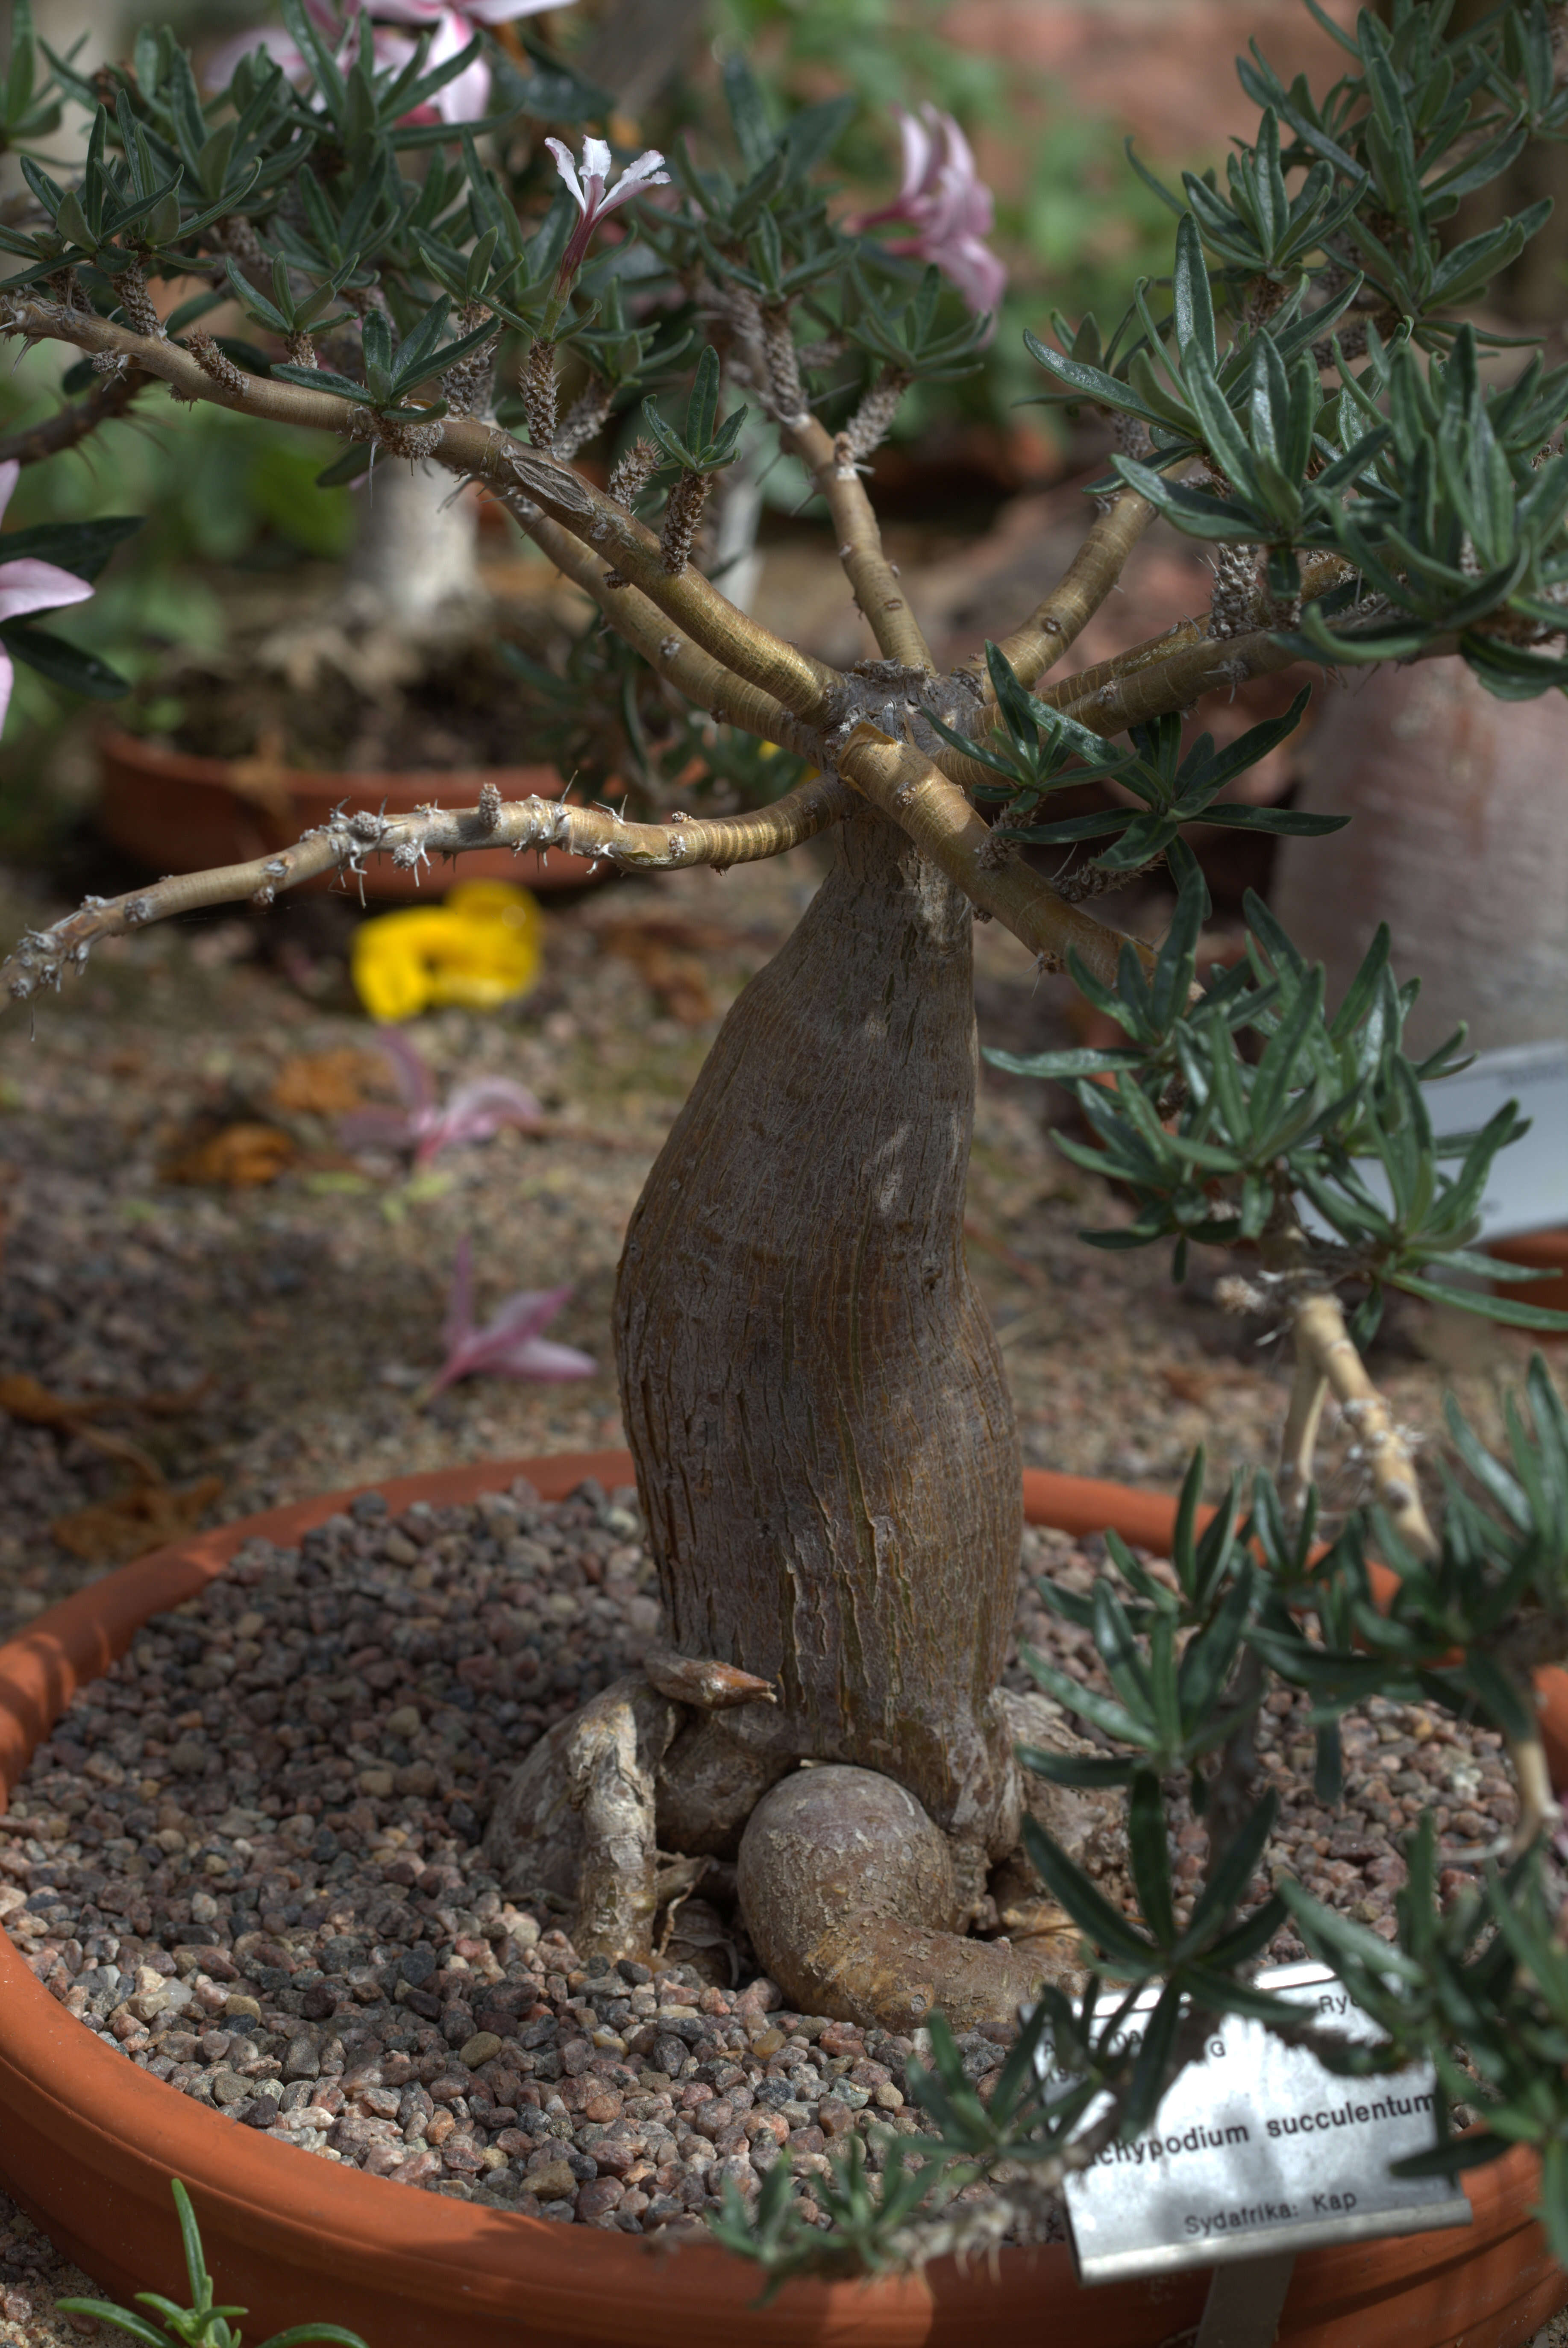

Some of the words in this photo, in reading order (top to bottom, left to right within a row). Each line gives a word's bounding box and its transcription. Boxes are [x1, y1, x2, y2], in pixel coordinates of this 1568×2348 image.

[1087, 2124, 1250, 2165] chypodium
[1266, 2094, 1434, 2137] succulentum
[1185, 2202, 1298, 2236] Sydafrika:
[1313, 2192, 1358, 2212] Kap
